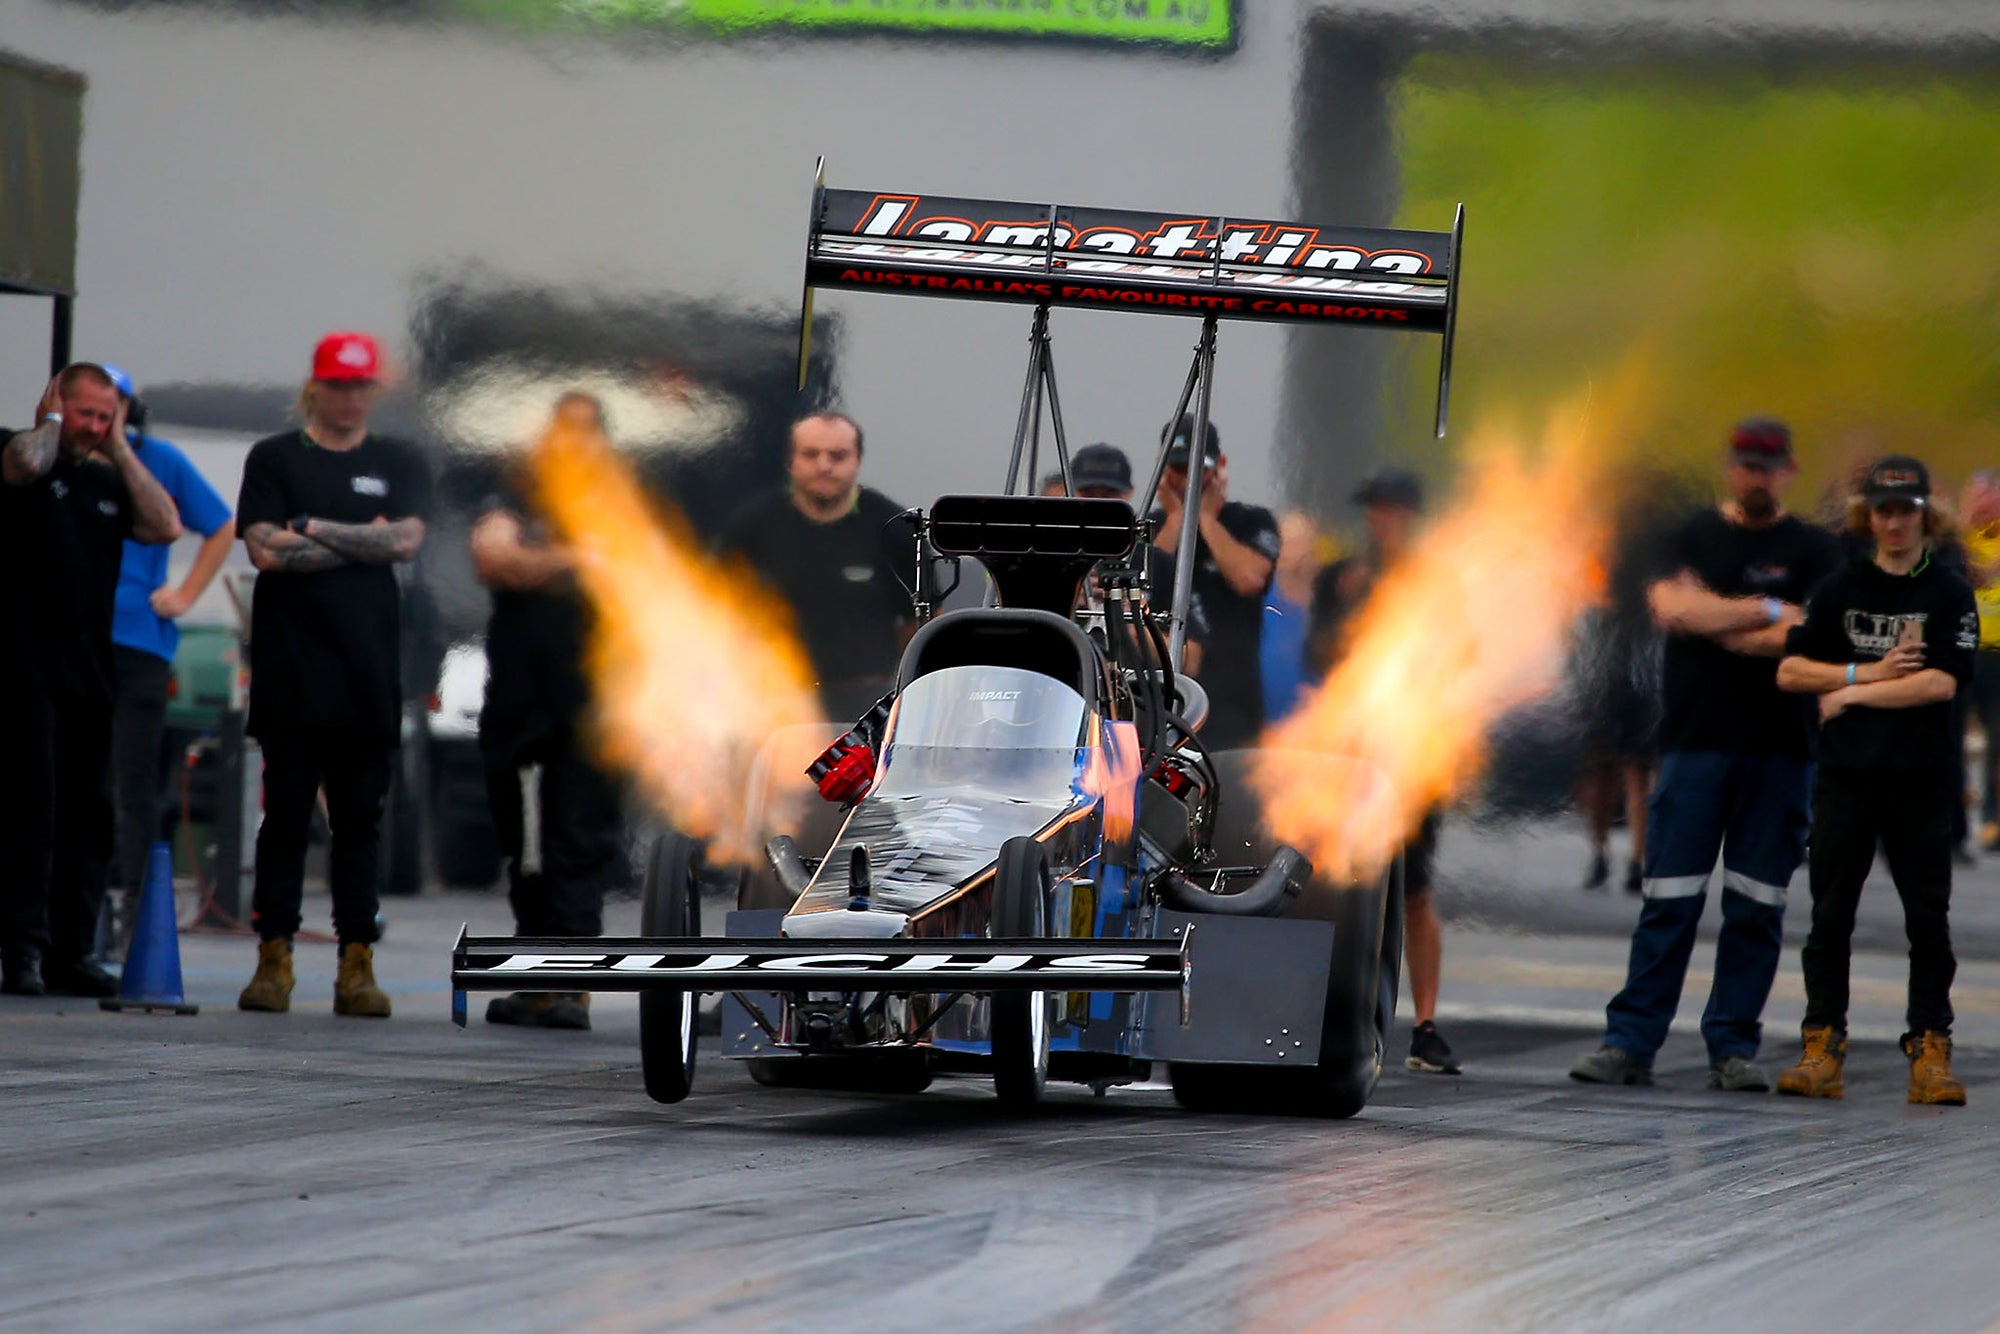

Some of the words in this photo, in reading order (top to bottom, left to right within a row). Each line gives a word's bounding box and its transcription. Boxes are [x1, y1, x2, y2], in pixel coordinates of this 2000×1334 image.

[840, 269, 1051, 296] AUSTRALIA'S
[1061, 285, 1241, 310] FAVOURITE
[1252, 299, 1409, 322] CARROTS
[968, 690, 1022, 701] IMPACT
[488, 954, 1151, 972] FUCHS
